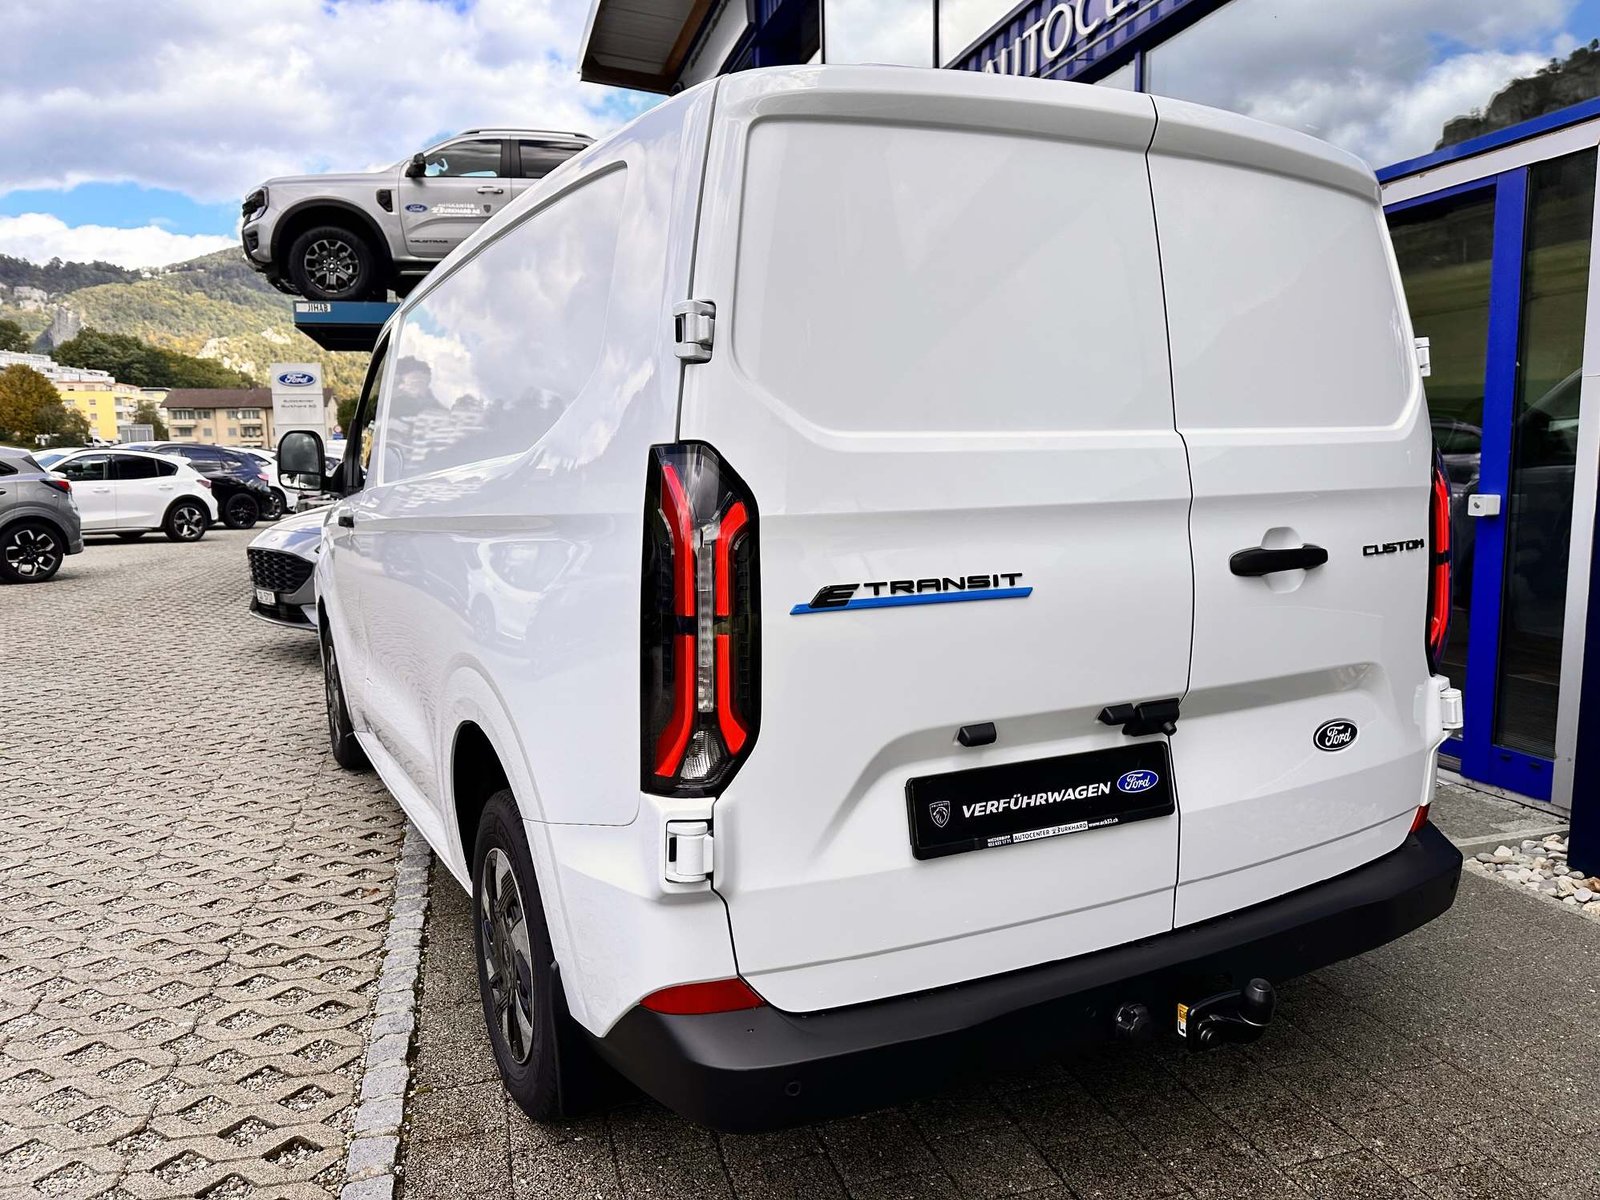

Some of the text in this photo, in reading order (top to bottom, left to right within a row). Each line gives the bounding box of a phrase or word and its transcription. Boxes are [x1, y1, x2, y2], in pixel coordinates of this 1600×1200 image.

[1363, 538, 1424, 556] CUSTOM
[863, 572, 1023, 596] TRANSIT
[1124, 772, 1151, 790] Ford
[962, 781, 1111, 818] VERFÜHRWAGEN
[1014, 829, 1050, 841] AUTOCENTER
